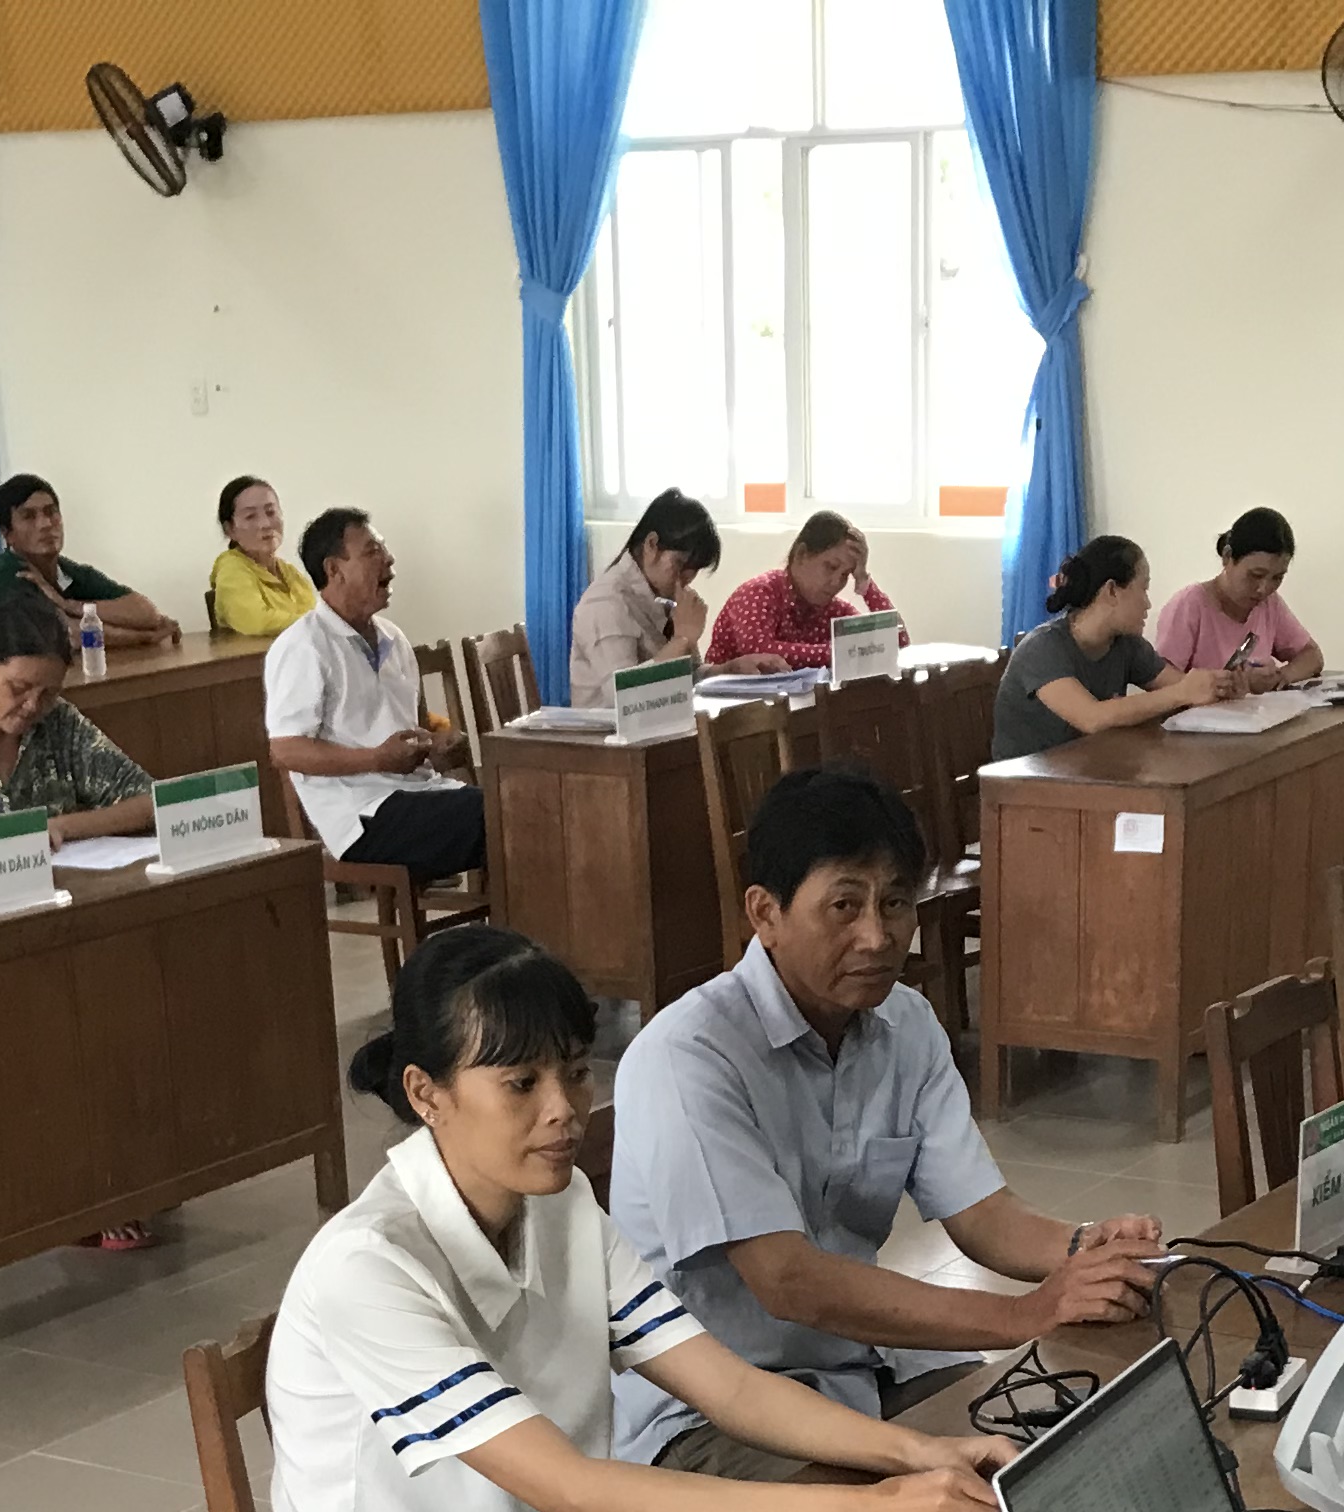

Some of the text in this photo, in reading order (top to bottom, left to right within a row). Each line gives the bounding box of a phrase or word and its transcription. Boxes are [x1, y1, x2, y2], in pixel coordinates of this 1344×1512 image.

[171, 807, 249, 838] HỘI NÔNG DÂN
[8, 854, 31, 873] DÂN
[1312, 1168, 1341, 1208] KIỂM
